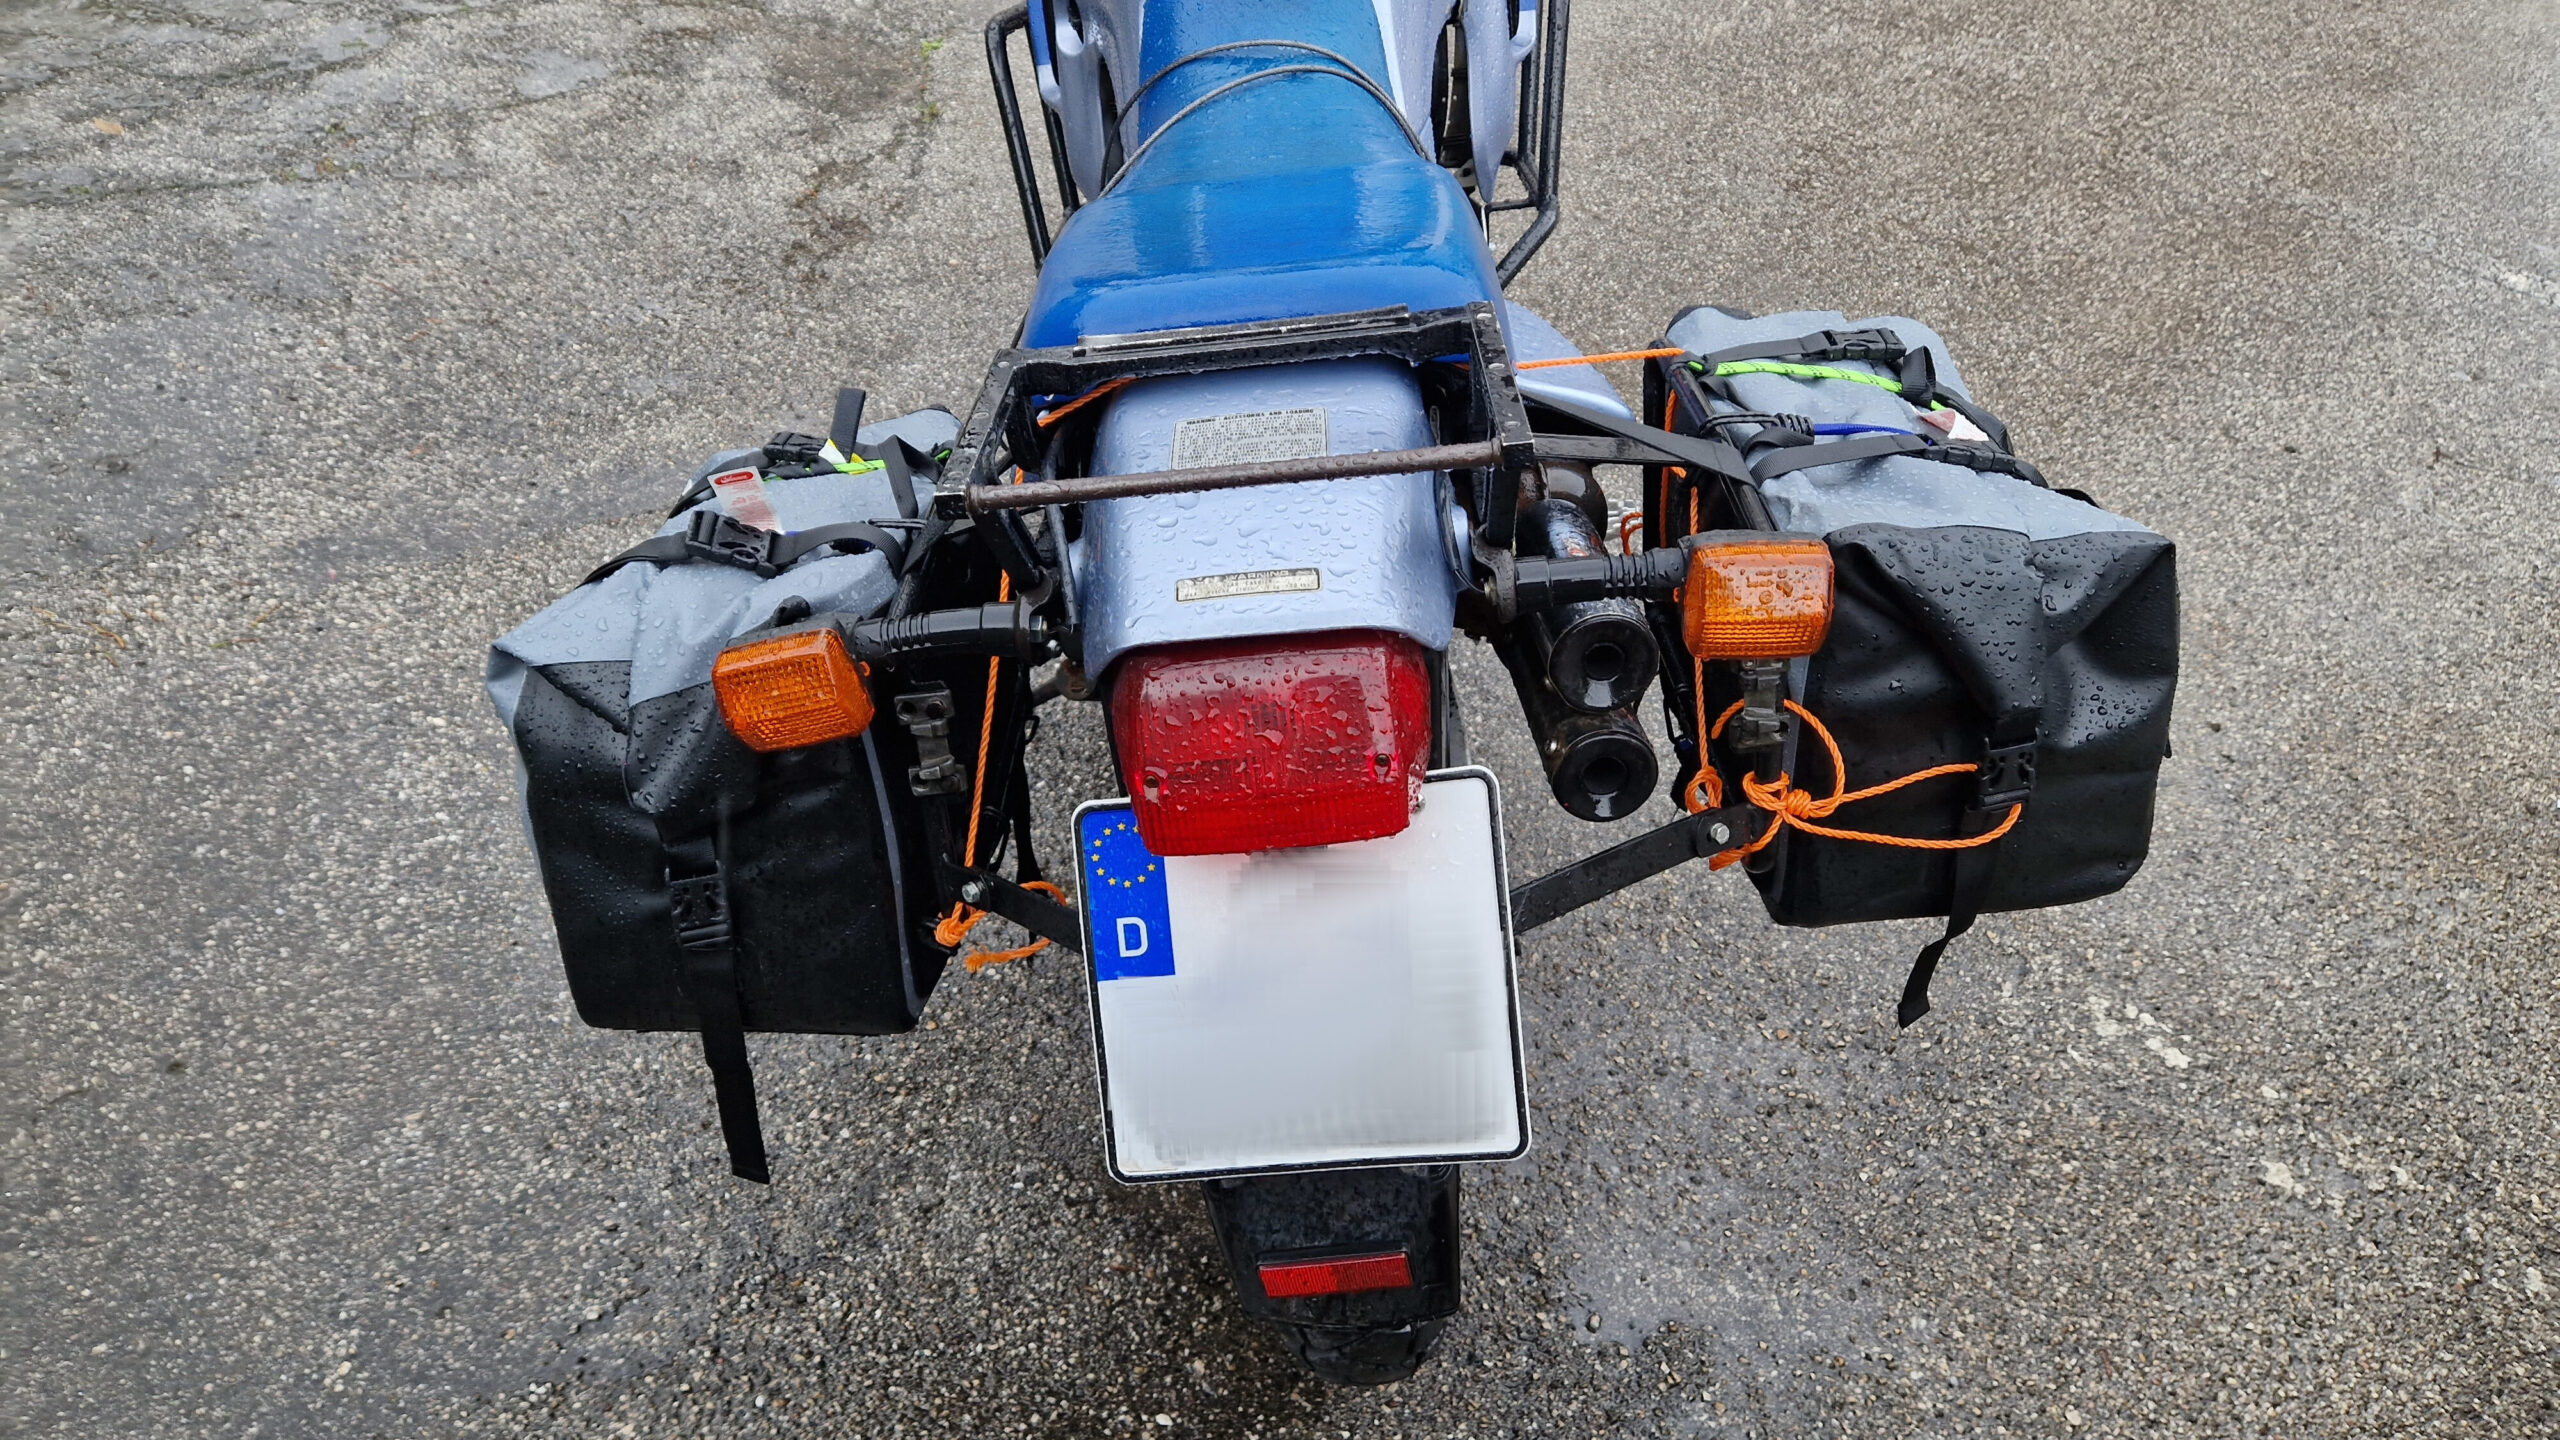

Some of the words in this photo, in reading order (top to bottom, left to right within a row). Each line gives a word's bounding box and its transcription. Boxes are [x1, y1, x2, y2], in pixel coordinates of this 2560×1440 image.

[1186, 417, 1216, 425] WARNING
[1223, 412, 1265, 420] ACCESSORIES
[1225, 570, 1289, 580] WARNING
[1116, 917, 1148, 958] D
